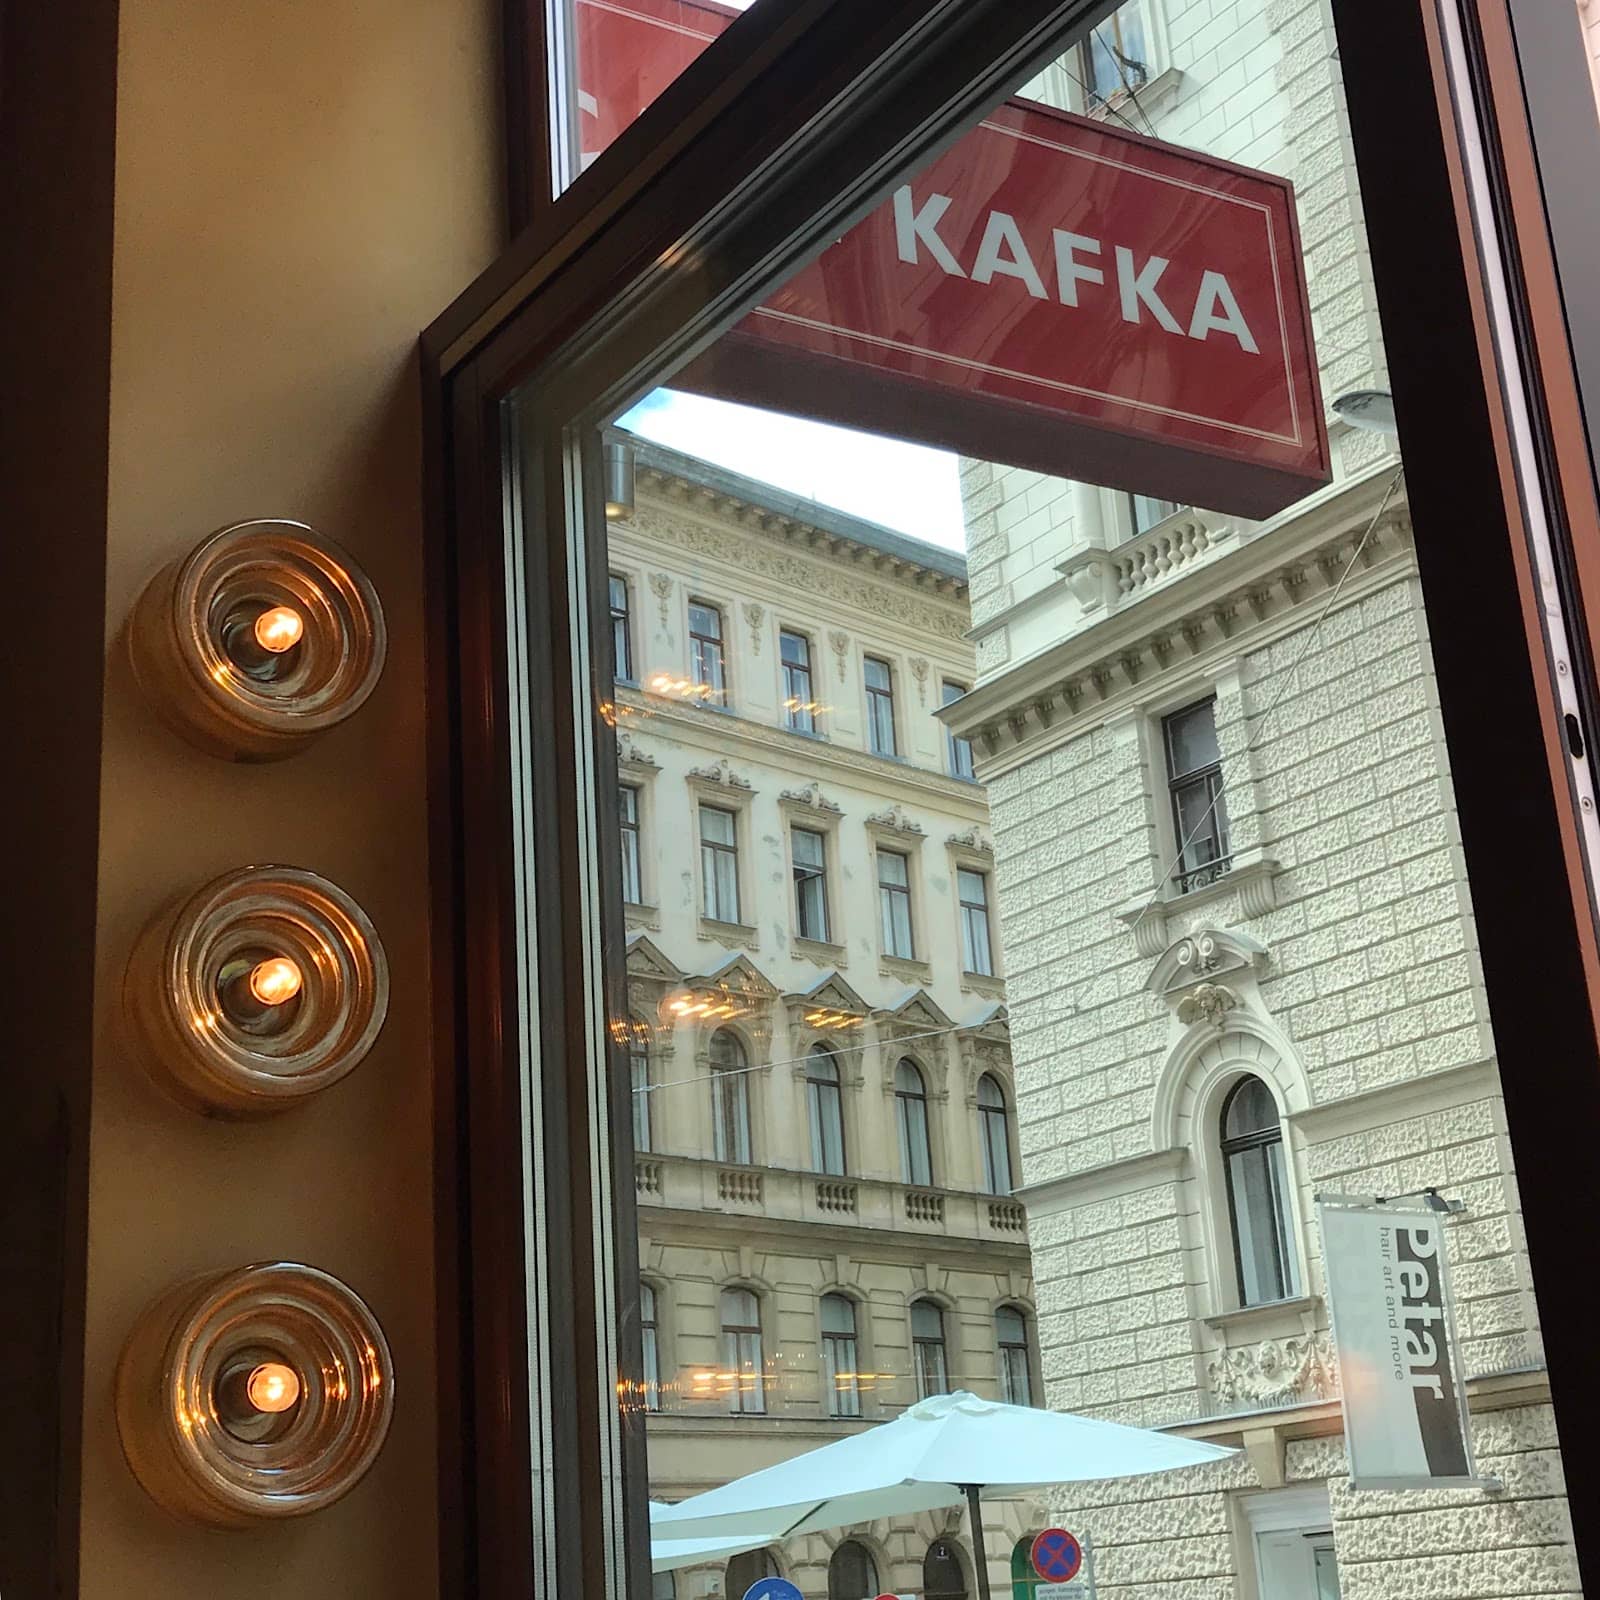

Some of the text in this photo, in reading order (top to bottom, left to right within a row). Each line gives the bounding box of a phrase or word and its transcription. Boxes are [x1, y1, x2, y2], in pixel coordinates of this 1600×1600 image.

[893, 184, 1261, 355] KAFKA
[1379, 1226, 1404, 1381] hair art and more
[1395, 1219, 1445, 1400] Petar
